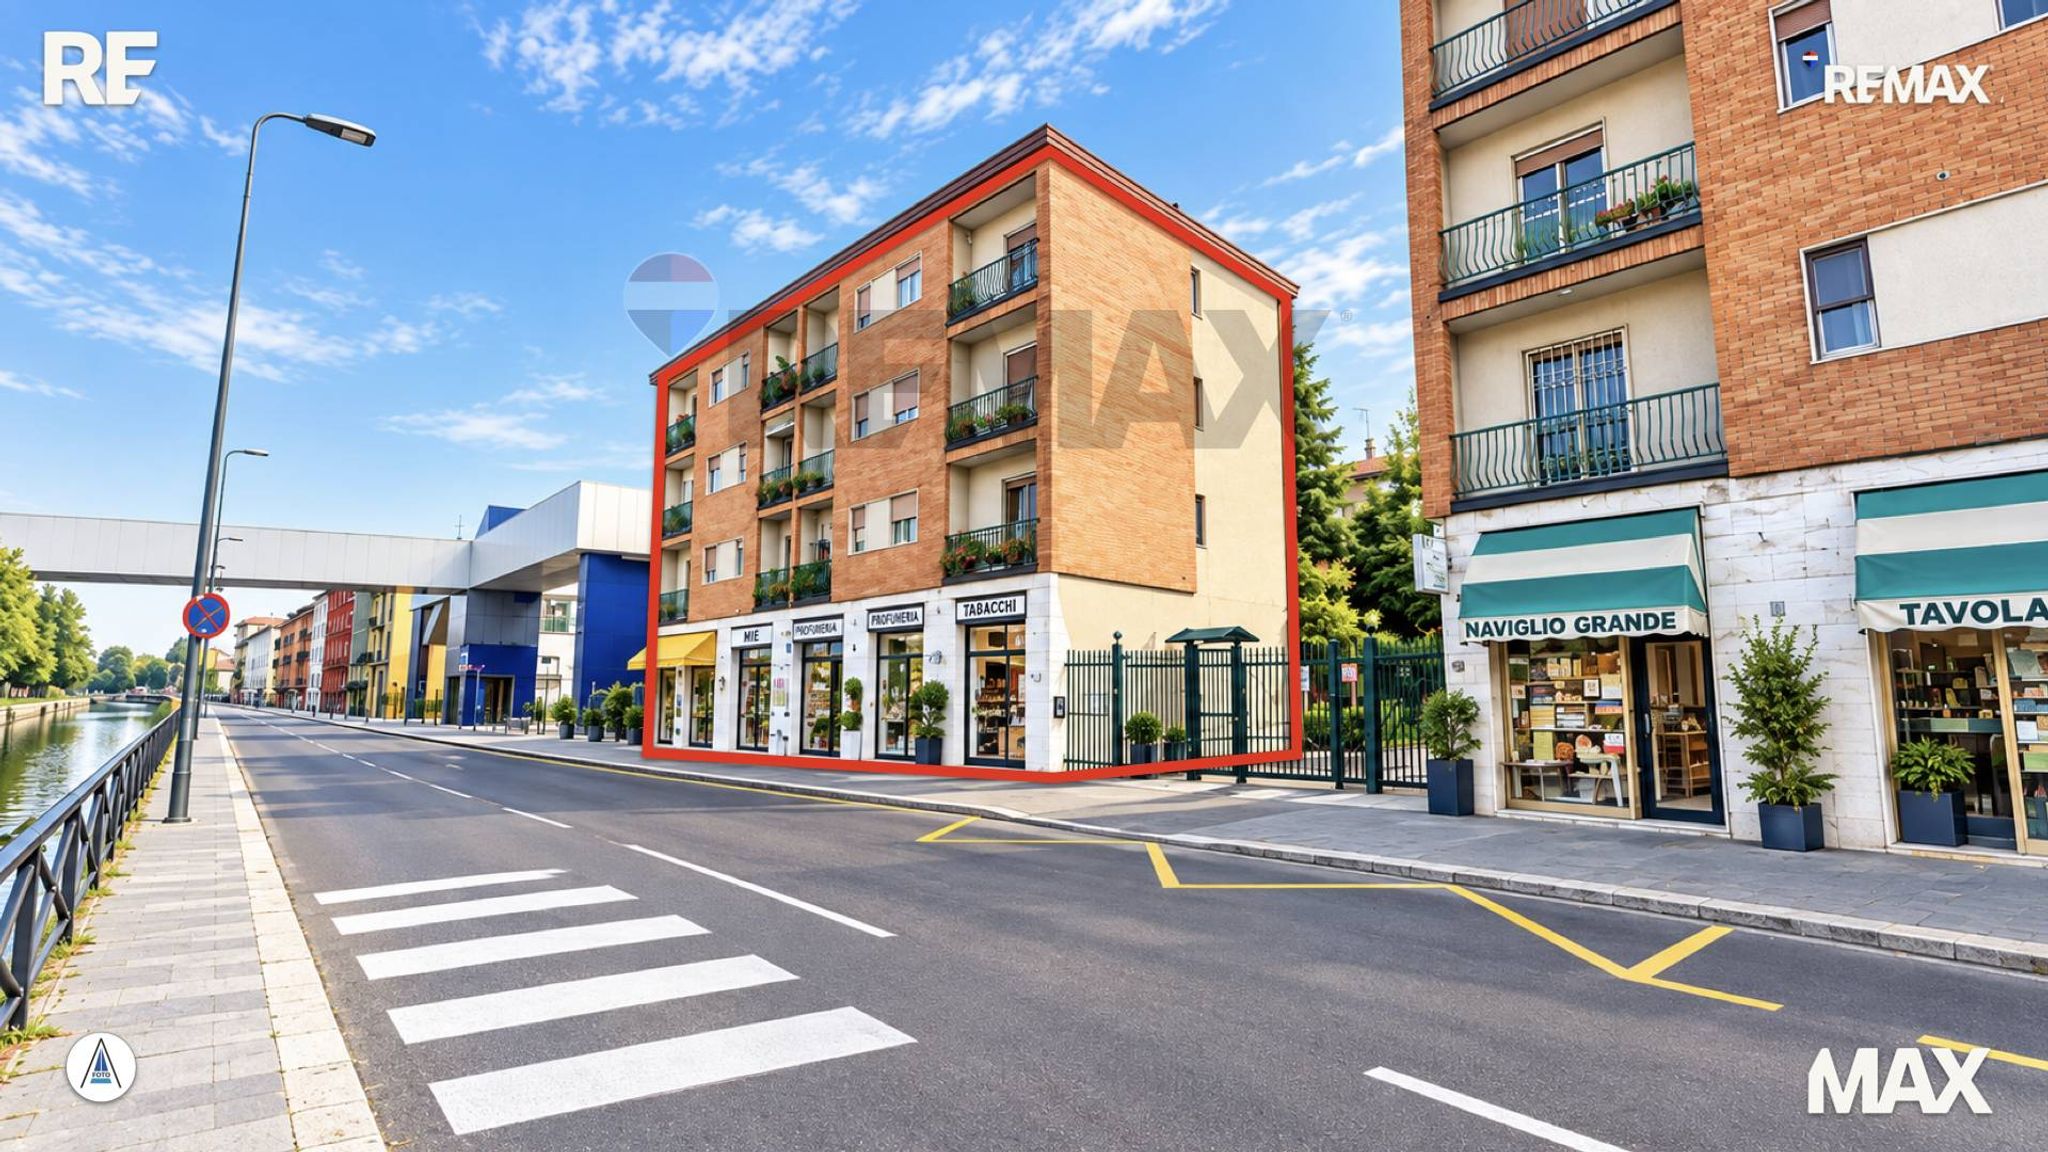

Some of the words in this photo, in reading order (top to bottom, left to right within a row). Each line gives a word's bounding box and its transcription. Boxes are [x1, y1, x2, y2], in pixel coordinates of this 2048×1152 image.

[963, 599, 1017, 617] TABACCHI
[1899, 597, 2048, 626] TAVOLA
[1465, 616, 1566, 638] NAVIGLIO
[1573, 611, 1677, 633] GRANDE
